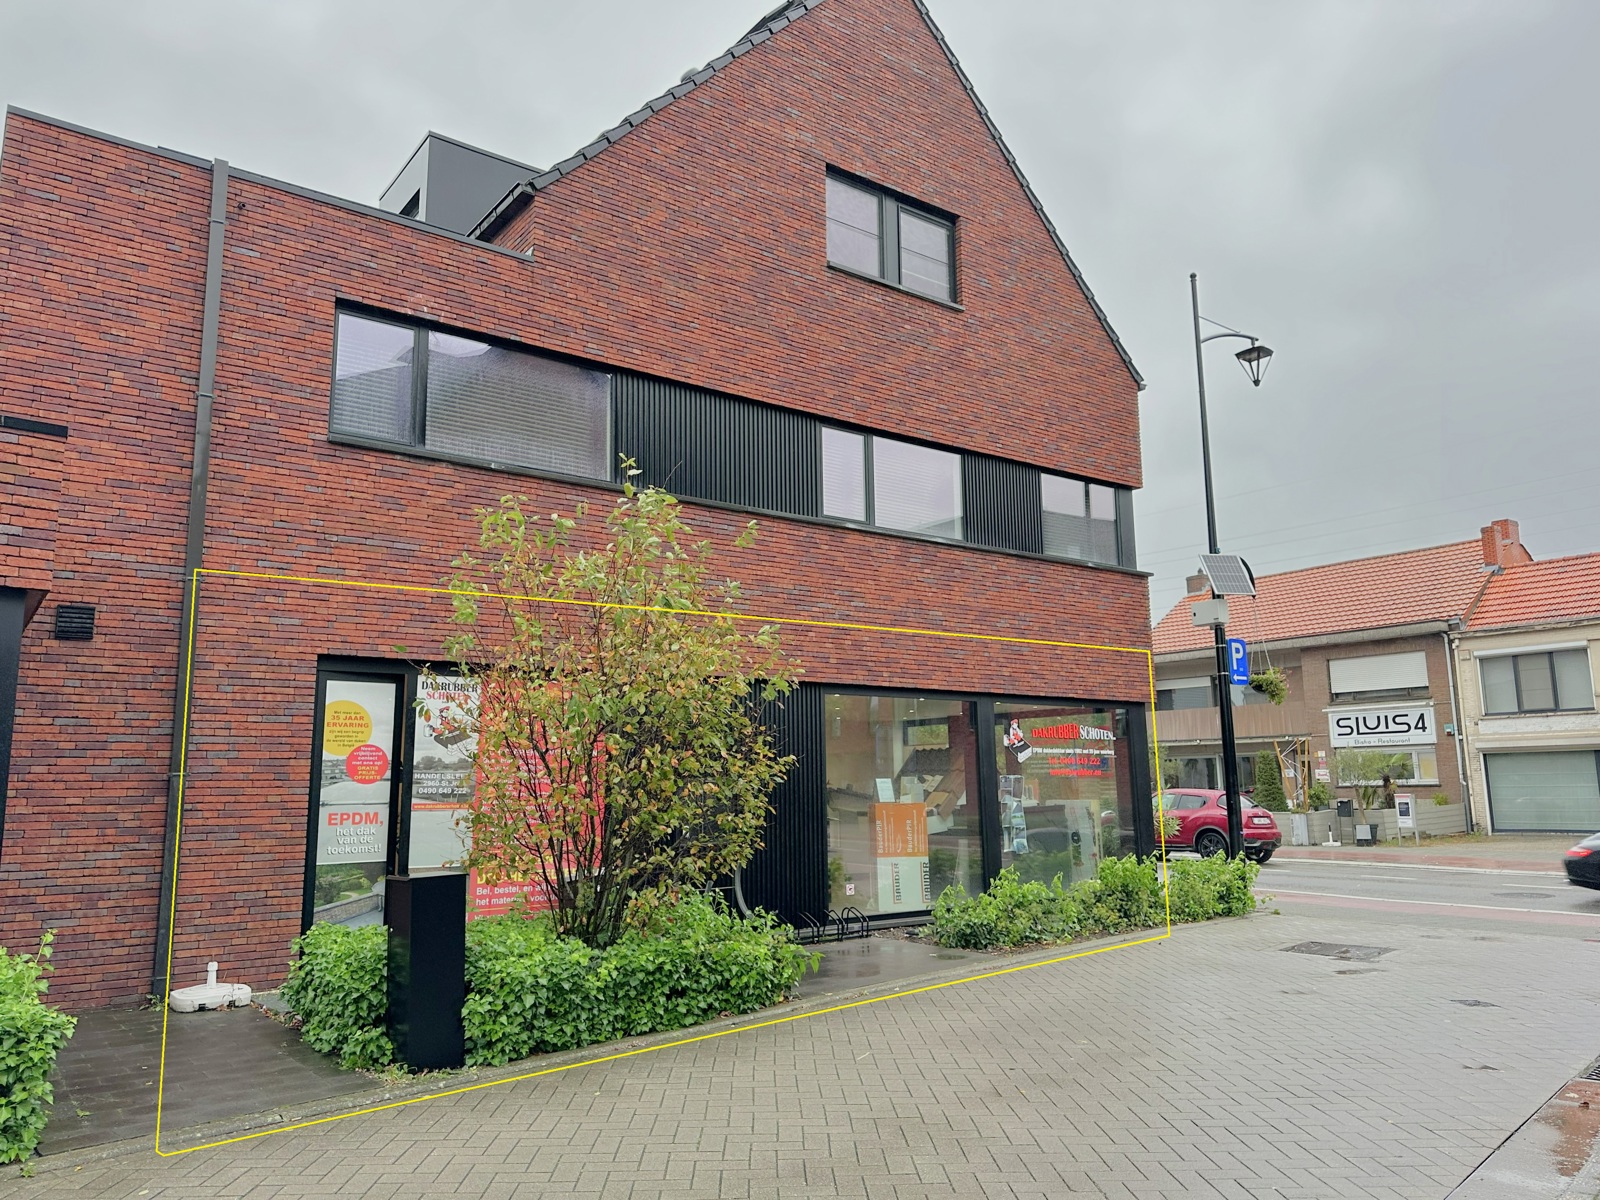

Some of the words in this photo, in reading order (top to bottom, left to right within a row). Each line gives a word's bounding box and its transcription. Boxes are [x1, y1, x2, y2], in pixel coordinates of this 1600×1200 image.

[1231, 642, 1243, 670] P
[426, 691, 469, 701] SCHTE
[1032, 723, 1079, 739] DAKRUBBER
[327, 811, 384, 827] EPDM,
[336, 827, 353, 836] het
[356, 826, 376, 836] dak
[337, 836, 357, 845] van
[359, 835, 374, 844] de
[327, 844, 382, 855] toekomst!
[476, 887, 492, 895] Bel,
[494, 885, 521, 894] bestel,
[476, 897, 489, 906] het
